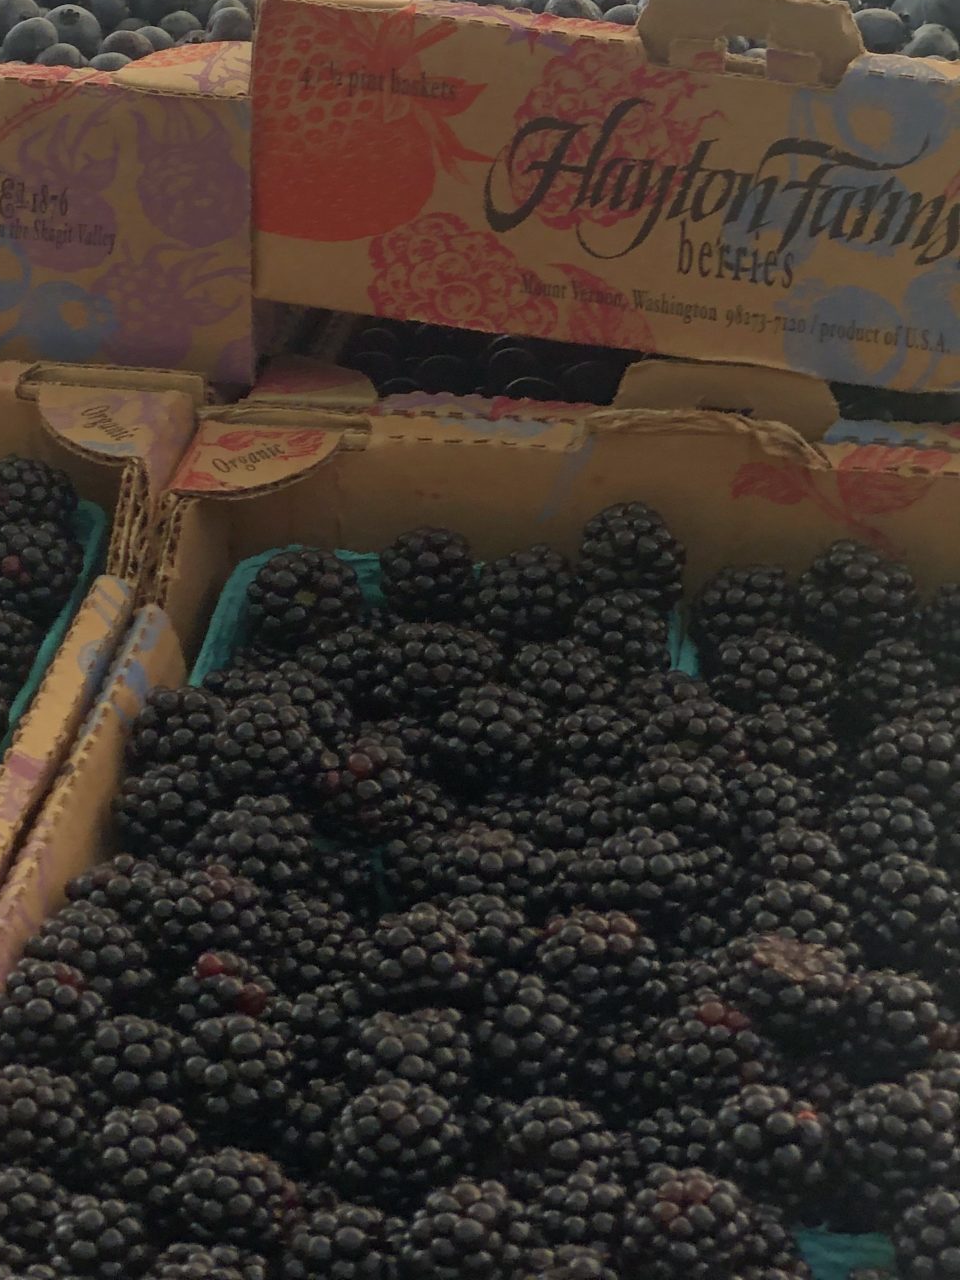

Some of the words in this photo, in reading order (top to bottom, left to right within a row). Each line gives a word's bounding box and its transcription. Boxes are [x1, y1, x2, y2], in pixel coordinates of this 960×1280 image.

[390, 67, 458, 101] baskets
[483, 97, 780, 260] Hayton
[754, 131, 960, 265] Farms
[9, 218, 30, 239] the
[33, 220, 73, 250] Skagit
[77, 223, 116, 255] Valley
[676, 218, 794, 289] berries
[521, 273, 567, 298] Mount
[632, 289, 717, 323] Washington
[820, 319, 880, 344] product
[884, 325, 904, 346] of
[905, 326, 951, 353] U.S.A.
[211, 441, 286, 473] Organic
